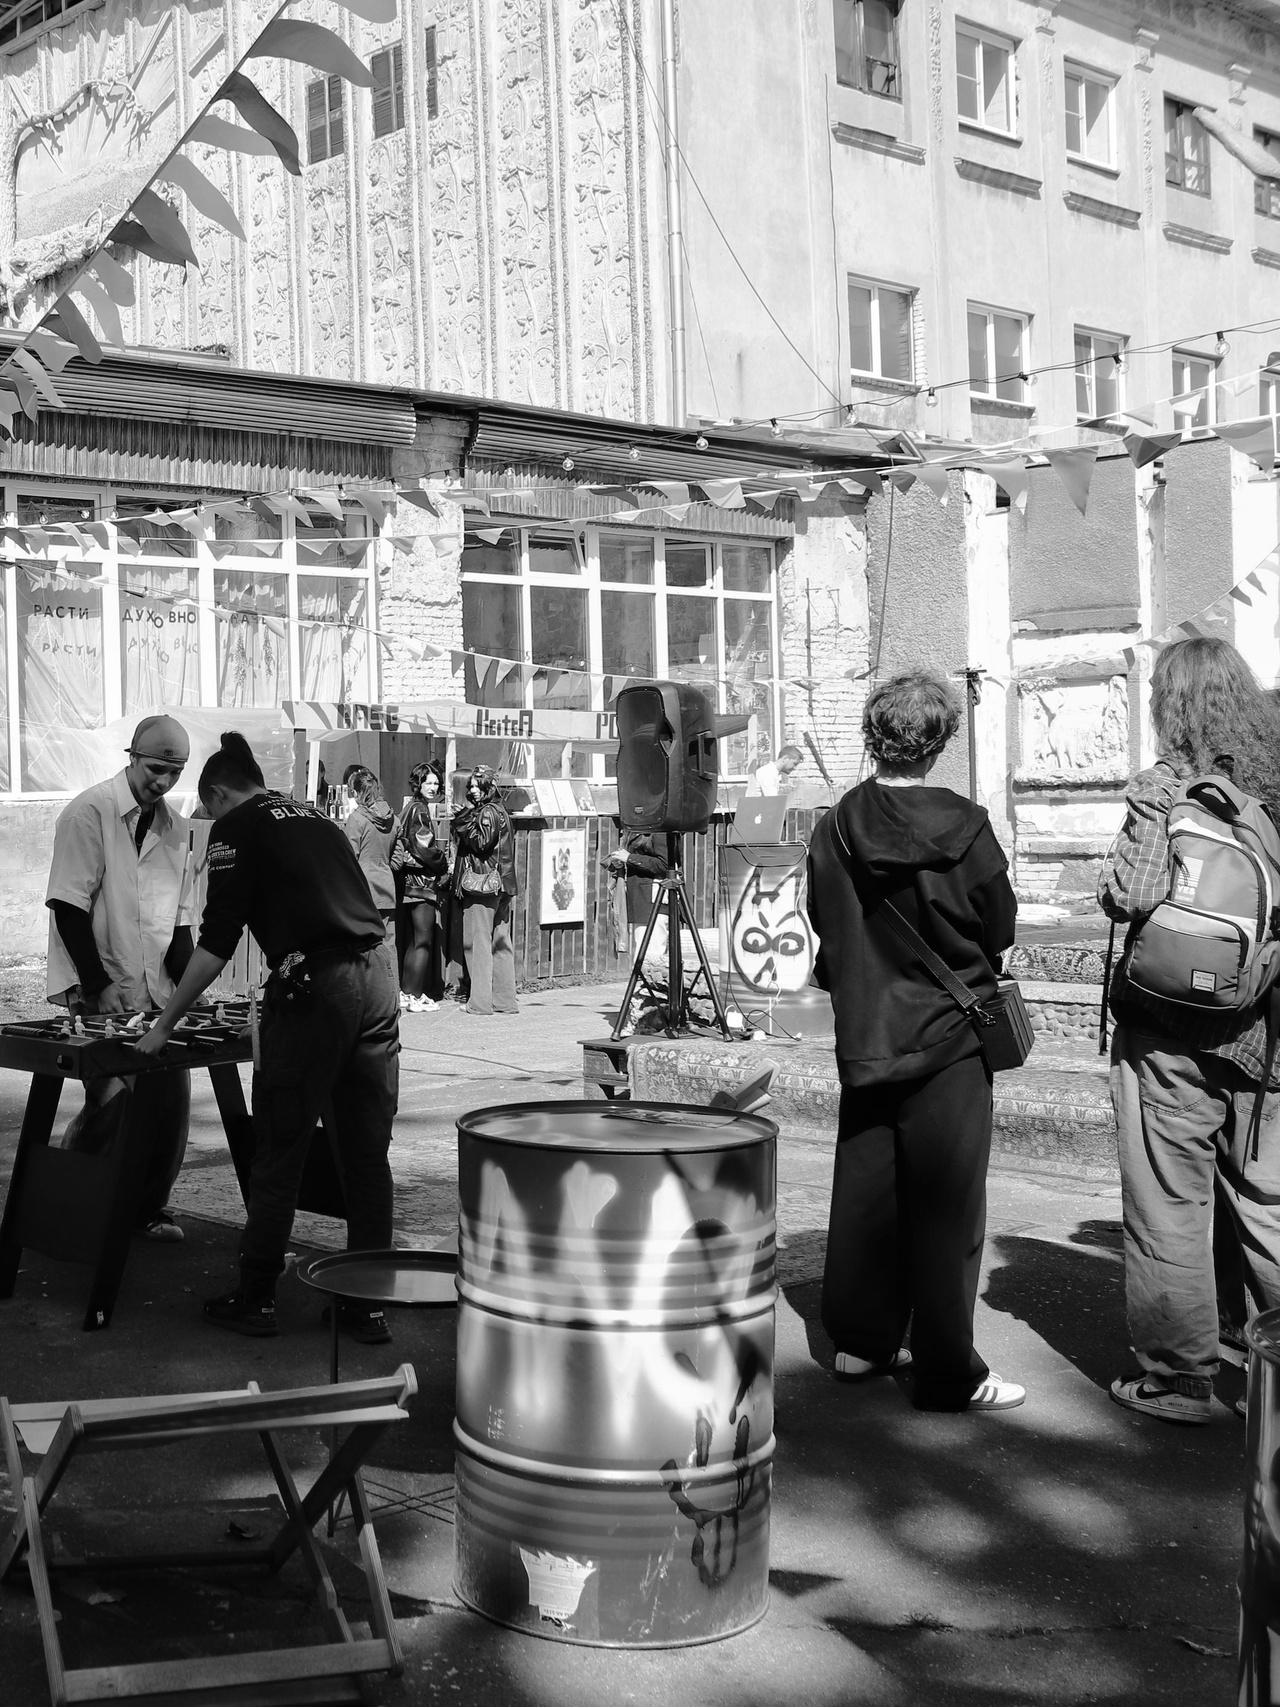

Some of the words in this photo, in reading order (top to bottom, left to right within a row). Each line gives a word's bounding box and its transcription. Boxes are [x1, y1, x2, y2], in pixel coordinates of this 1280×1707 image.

[34, 604, 89, 620] РАСТИ
[270, 806, 317, 820] BLUE
[1177, 885, 1196, 895] YES
